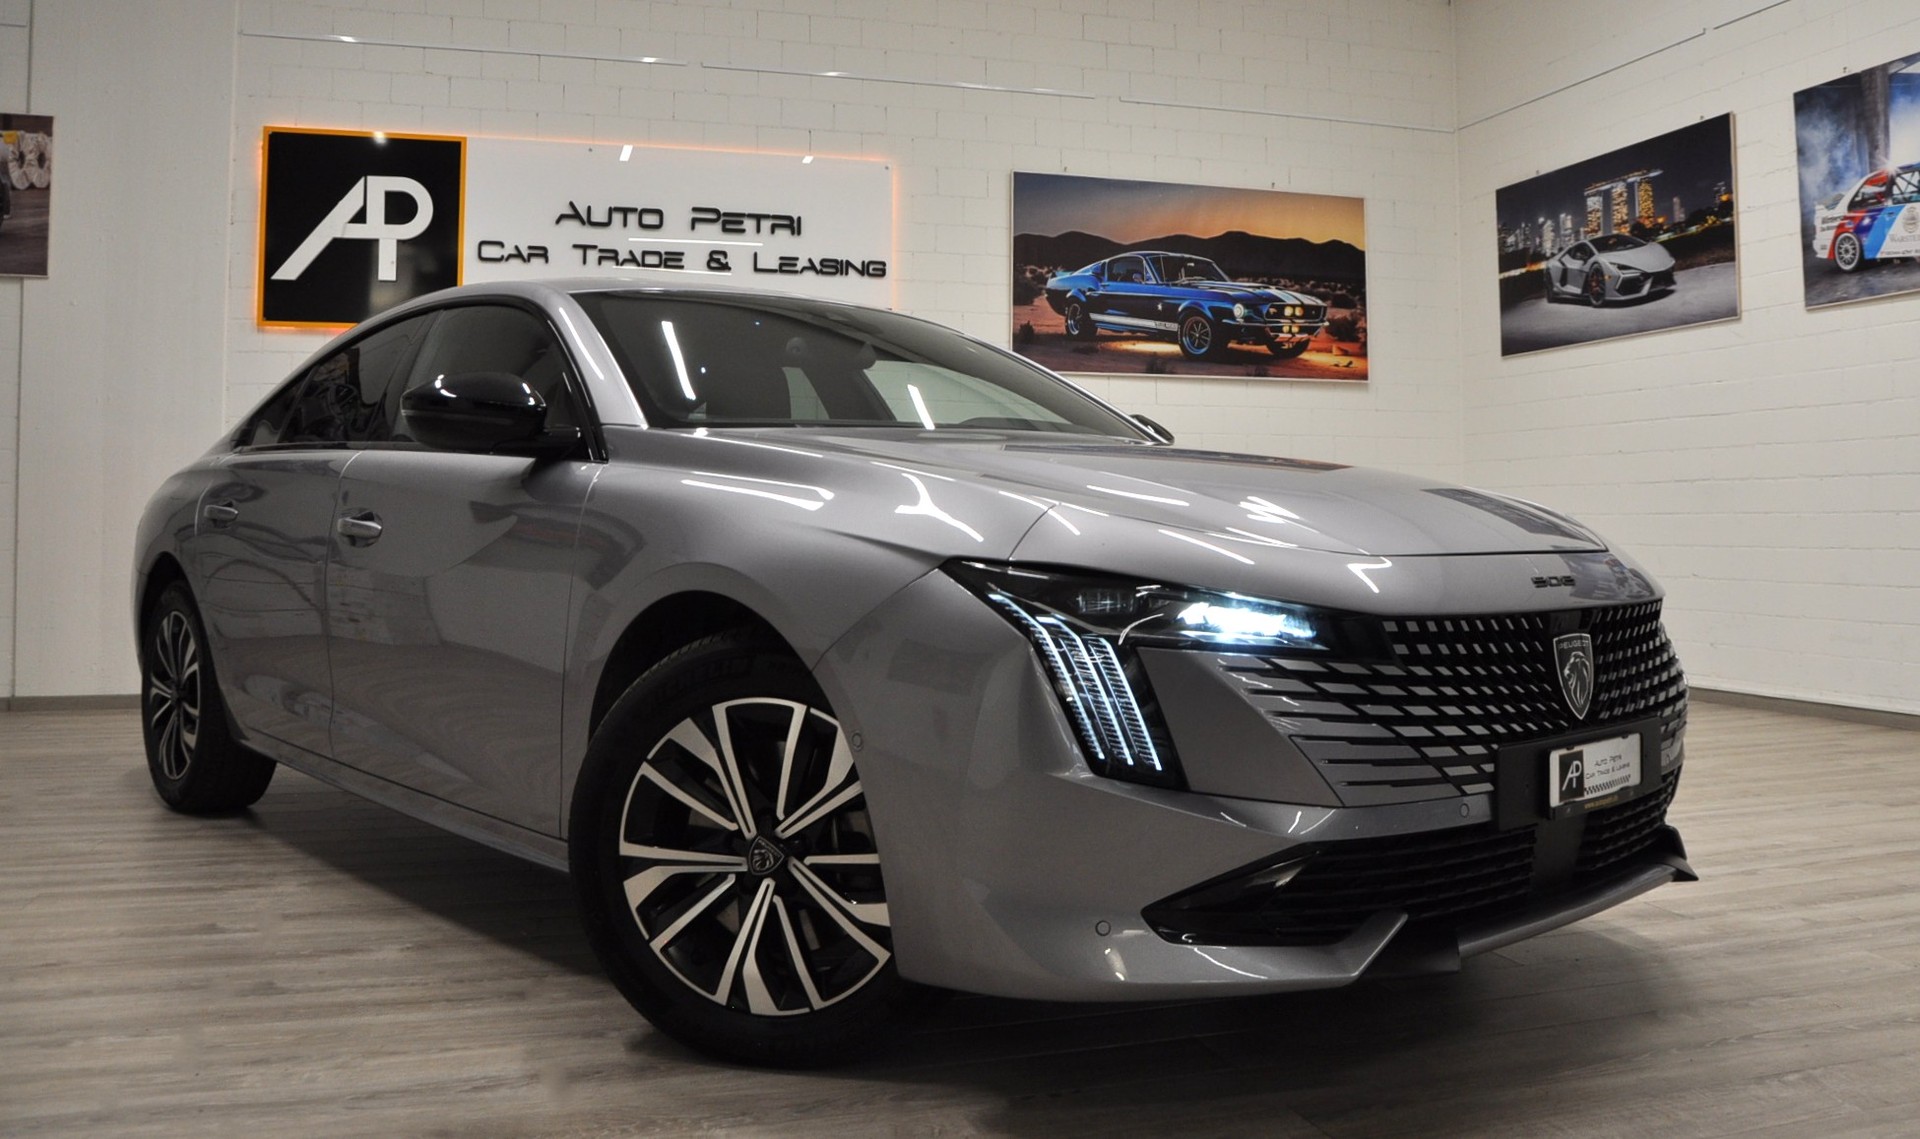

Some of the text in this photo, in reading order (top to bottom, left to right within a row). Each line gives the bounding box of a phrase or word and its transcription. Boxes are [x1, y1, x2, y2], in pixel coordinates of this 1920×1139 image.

[270, 175, 434, 282] AP
[555, 200, 802, 236] AUTO PETRI
[476, 240, 888, 278] CAR TRADE & LEASING
[1531, 575, 1576, 588] 508
[1562, 760, 1582, 791] AP
